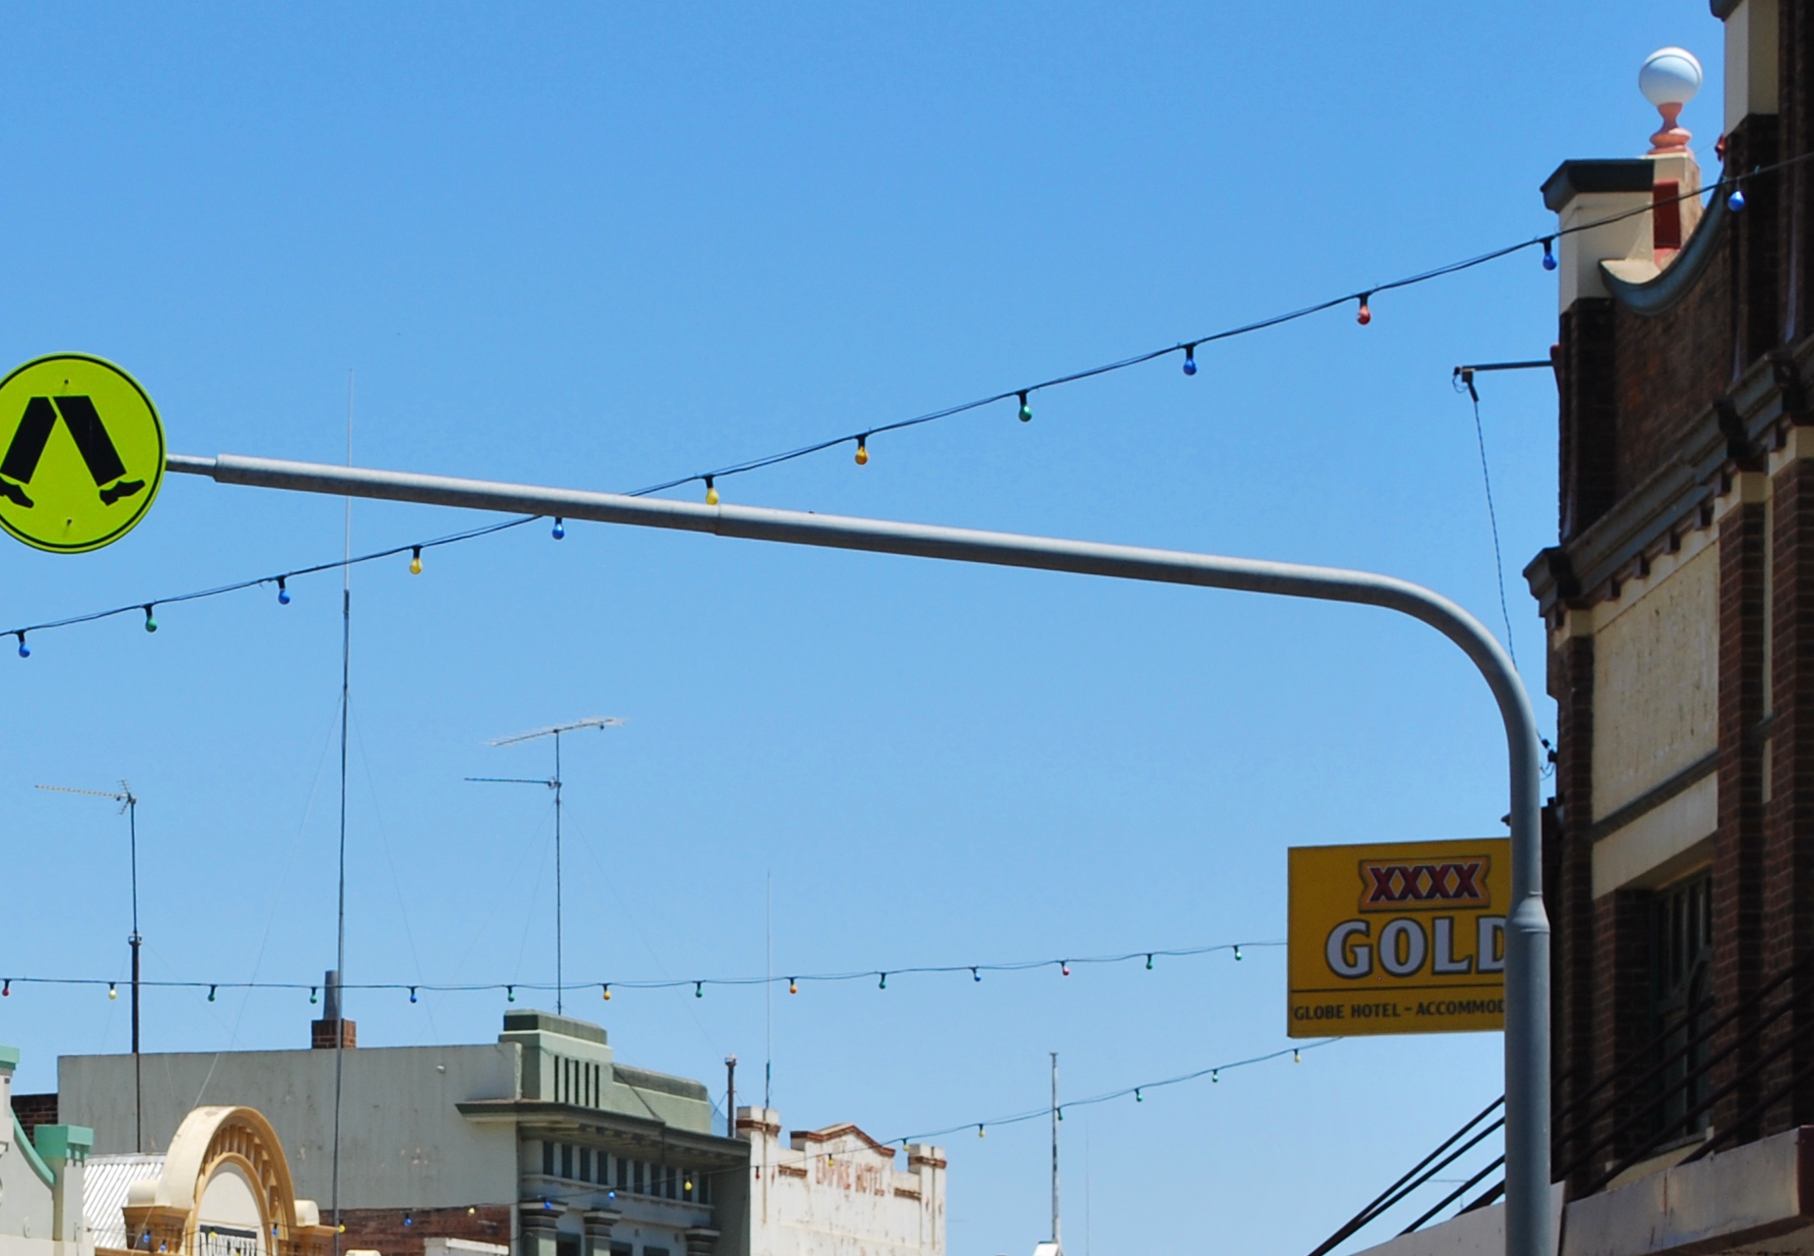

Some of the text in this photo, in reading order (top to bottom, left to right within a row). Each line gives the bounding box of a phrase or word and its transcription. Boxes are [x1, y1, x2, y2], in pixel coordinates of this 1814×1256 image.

[1367, 861, 1483, 903] XXXX
[1324, 914, 1506, 979] GOLD
[1294, 1004, 1345, 1021] GLOBE
[1351, 1002, 1401, 1018] HOTEL
